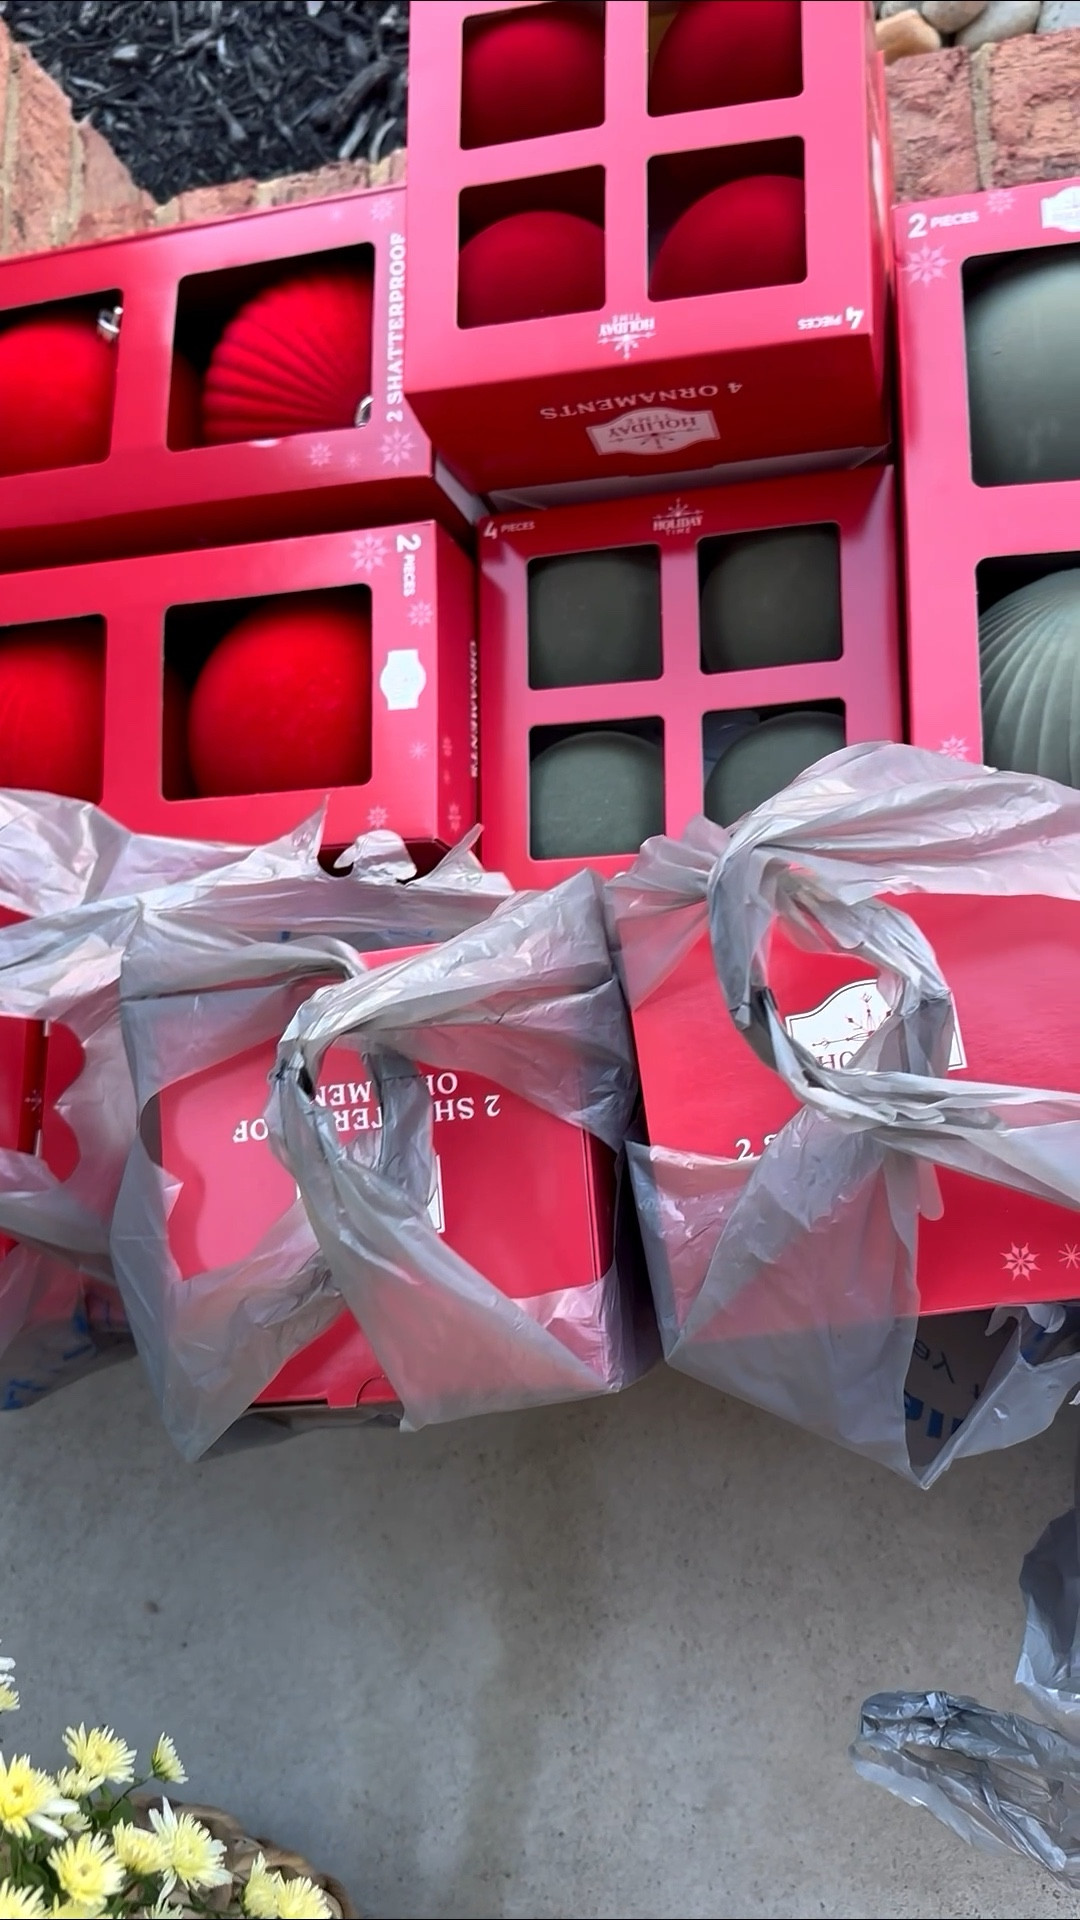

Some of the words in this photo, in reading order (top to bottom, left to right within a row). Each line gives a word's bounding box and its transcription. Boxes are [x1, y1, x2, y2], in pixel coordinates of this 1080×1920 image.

[908, 213, 928, 239] 2
[931, 211, 979, 228] PIECES
[387, 233, 406, 405] SHATTERPROOF
[599, 317, 655, 336] HOLIDAY
[797, 314, 842, 330] PIECES
[846, 307, 864, 329] 4
[728, 382, 743, 394] 4
[540, 385, 718, 420] ORNAMENTS
[386, 410, 403, 422] 2
[608, 417, 697, 439] HOLIDAY
[483, 521, 497, 540] 4
[500, 520, 535, 533] PIECES
[653, 515, 703, 532] HOLIDAY
[396, 533, 422, 553] 2
[403, 554, 416, 597] PIECES
[485, 1094, 500, 1117] 2
[735, 1138, 755, 1161] 2
